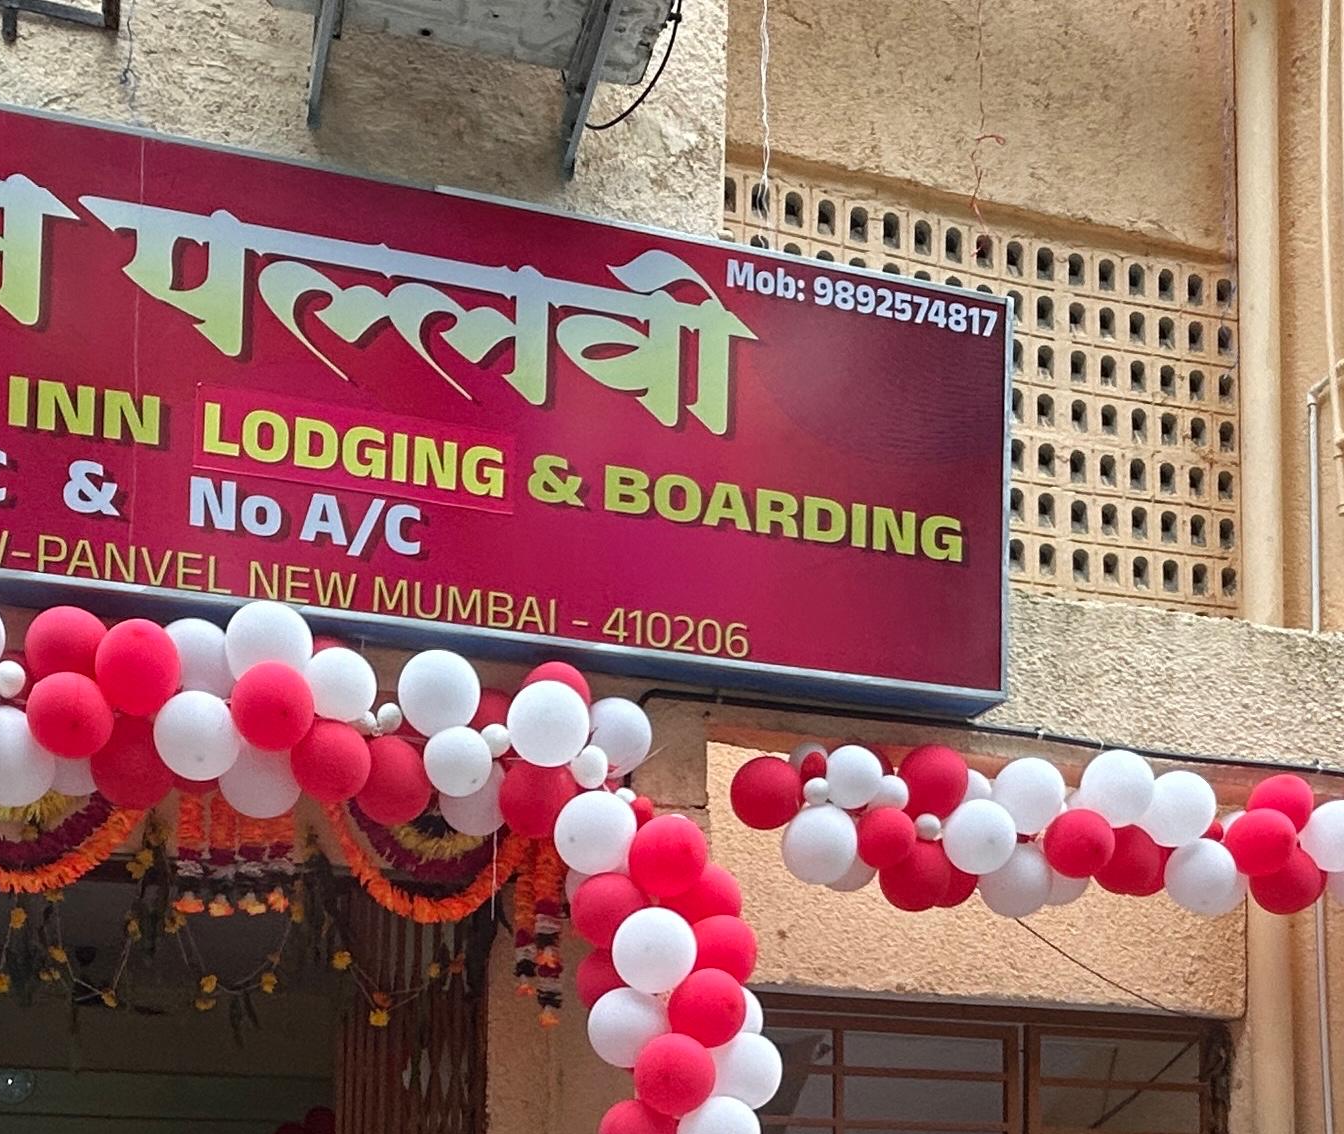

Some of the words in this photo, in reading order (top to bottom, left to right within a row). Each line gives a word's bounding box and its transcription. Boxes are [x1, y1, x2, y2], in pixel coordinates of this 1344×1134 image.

[78, 196, 759, 436] पल्लवी
[726, 259, 805, 301] Mob:
[813, 276, 997, 337] 9892574817
[8, 376, 161, 446] INN
[202, 402, 504, 498] LODGING
[527, 455, 584, 507] &
[604, 464, 964, 563] BOARDING
[63, 460, 119, 516] &
[189, 475, 282, 537] No
[299, 493, 422, 557] A/C
[249, 560, 358, 607] NEW
[373, 576, 557, 635] MUMBAI
[602, 607, 750, 658] 410206
